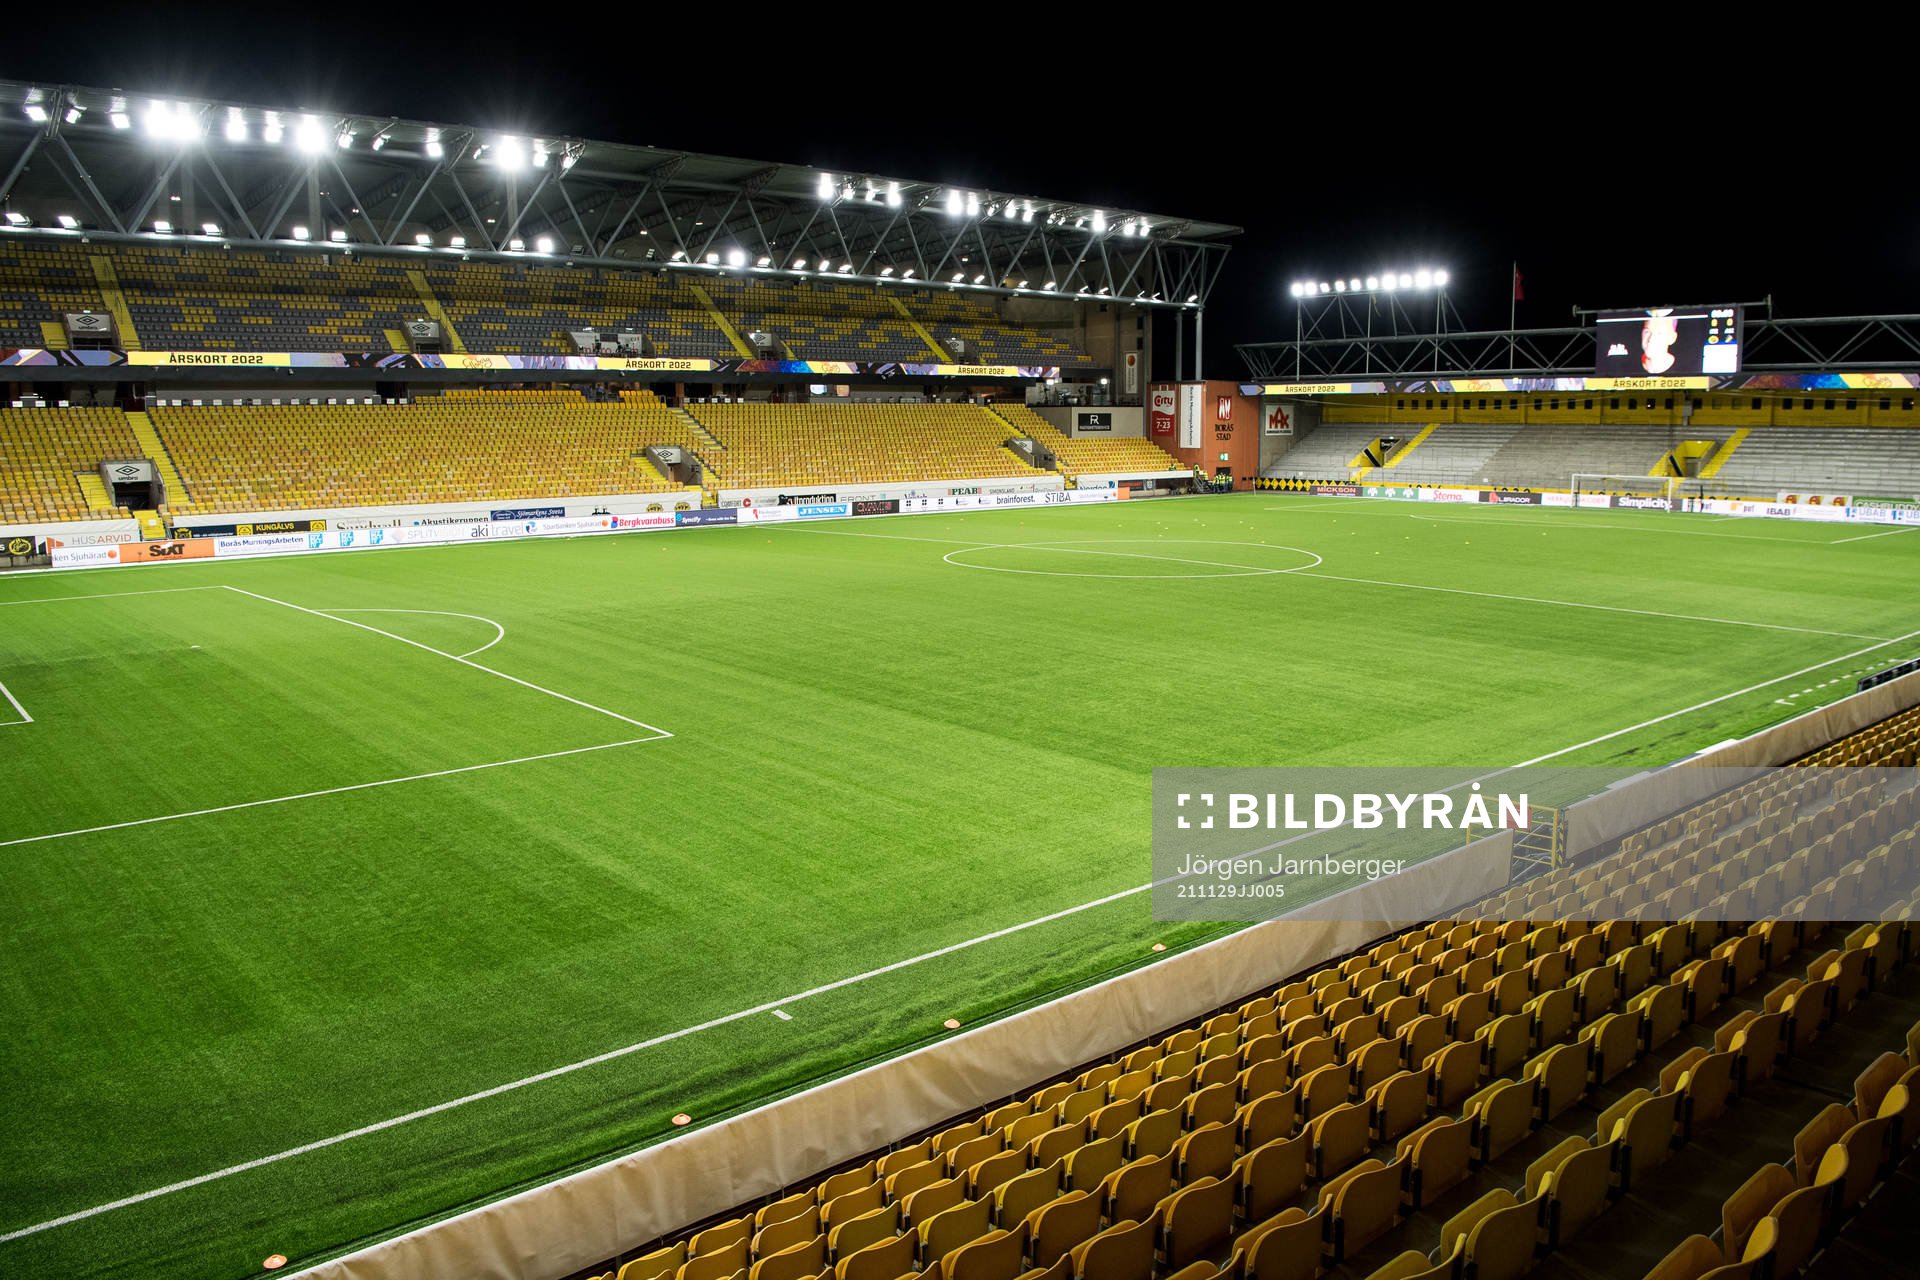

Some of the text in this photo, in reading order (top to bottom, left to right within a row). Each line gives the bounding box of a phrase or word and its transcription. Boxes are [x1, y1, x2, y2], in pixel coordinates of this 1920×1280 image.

[169, 353, 263, 364] ÅRSKORT 2022
[626, 359, 691, 369] ÅRSKORT 2022
[958, 366, 987, 374] ÅRSKORT
[1614, 380, 1657, 388] ÅRSKORT
[1215, 422, 1234, 432] BORÅS
[951, 487, 978, 496] PEAB
[1045, 491, 1072, 503] STIBA
[800, 504, 846, 515] JENSEN
[471, 523, 524, 538] aki travel
